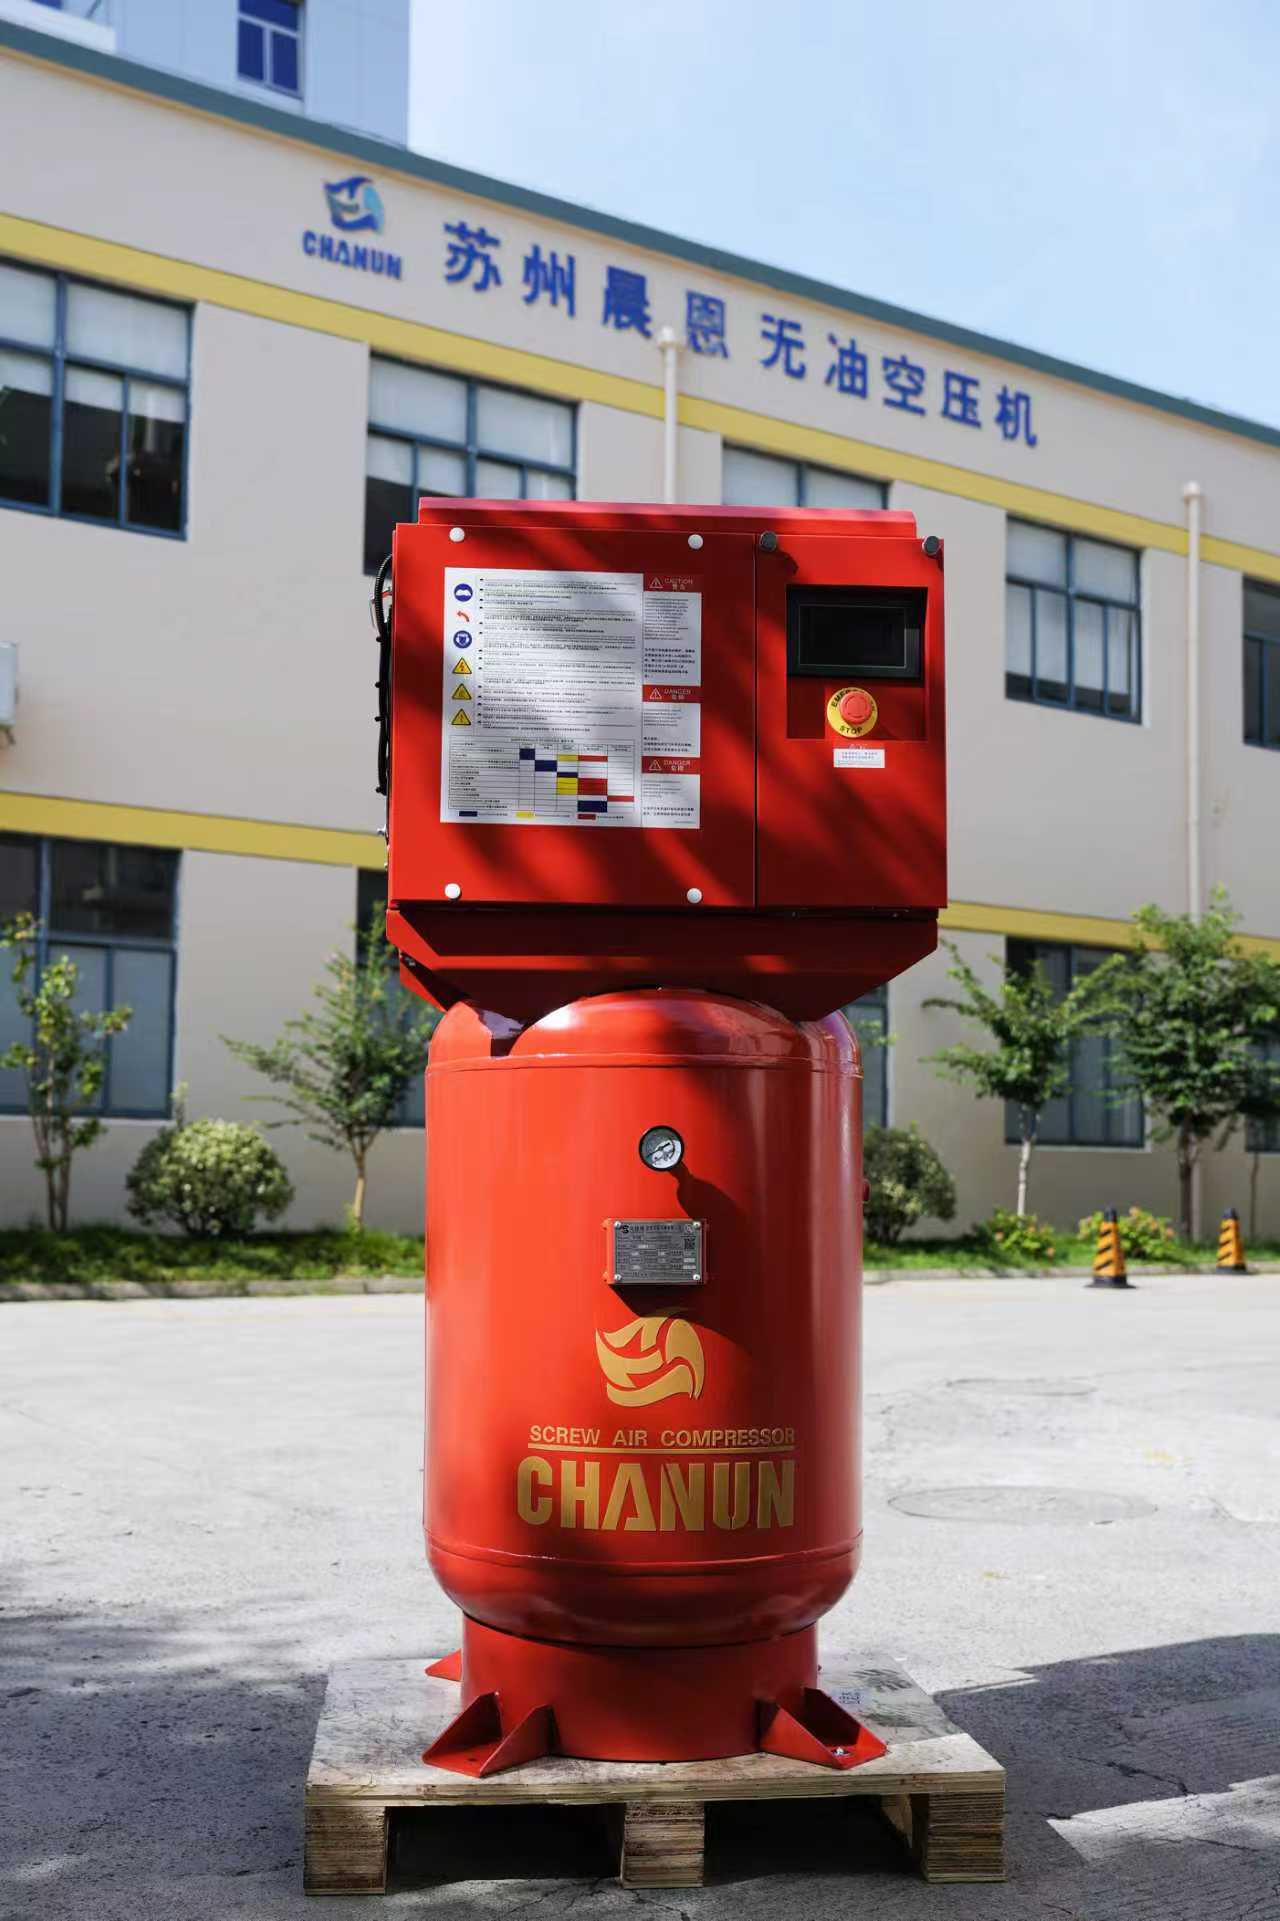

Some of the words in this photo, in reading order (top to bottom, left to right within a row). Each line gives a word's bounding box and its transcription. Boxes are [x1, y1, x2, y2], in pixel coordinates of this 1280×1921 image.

[302, 230, 403, 280] CHANUN
[840, 725, 863, 735] STOP
[529, 1425, 600, 1446] SCREW
[612, 1429, 648, 1447] AIR
[660, 1427, 795, 1448] COMPRESSOR
[516, 1455, 796, 1532] CHANUN
